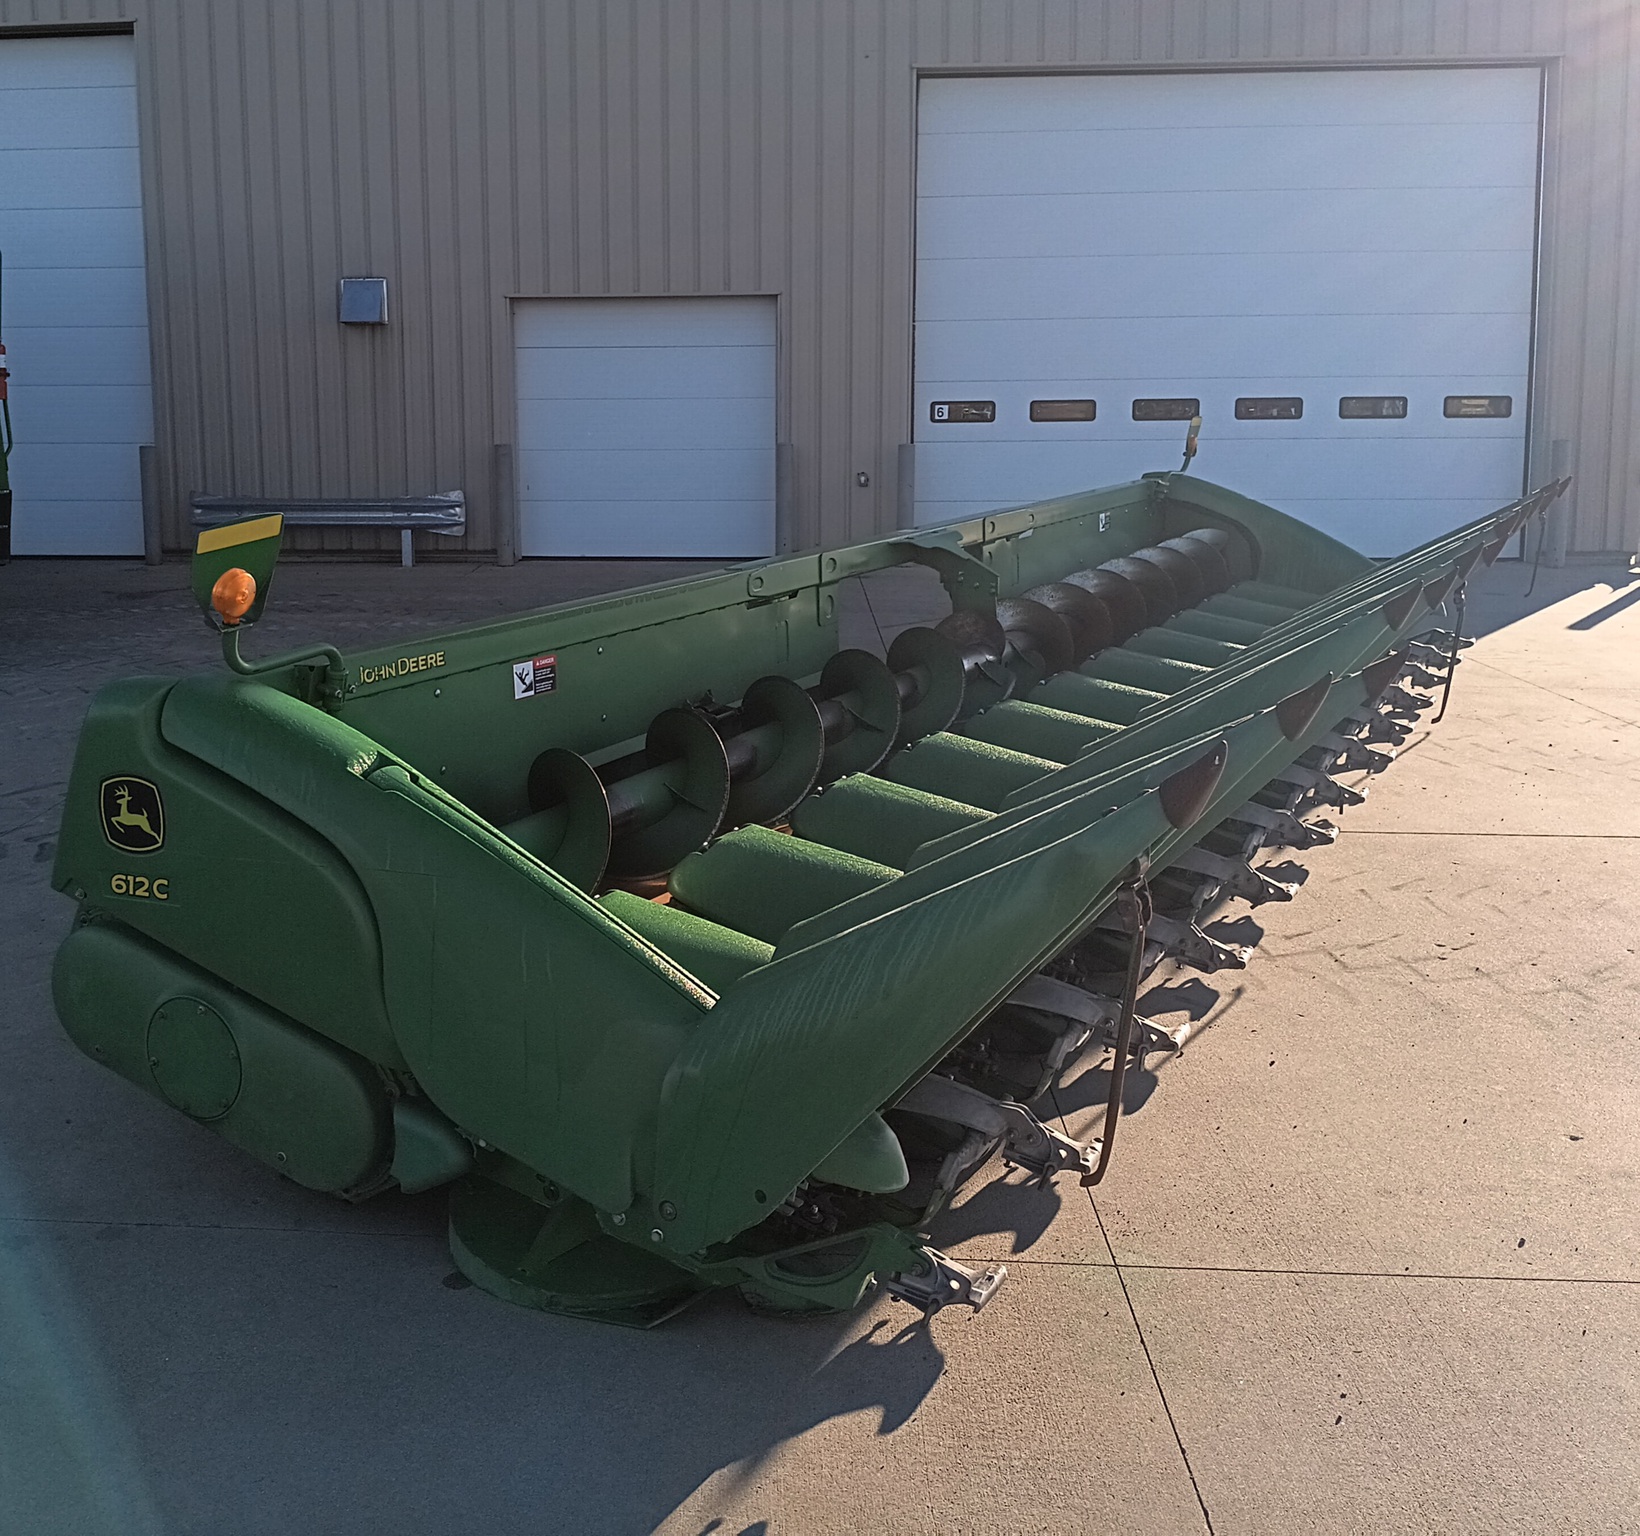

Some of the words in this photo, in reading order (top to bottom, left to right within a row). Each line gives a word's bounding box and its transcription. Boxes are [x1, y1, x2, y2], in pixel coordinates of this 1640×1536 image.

[936, 407, 945, 418] 6
[359, 663, 396, 684] JOHN
[397, 651, 445, 675] DEERE
[111, 874, 169, 899] 612C
